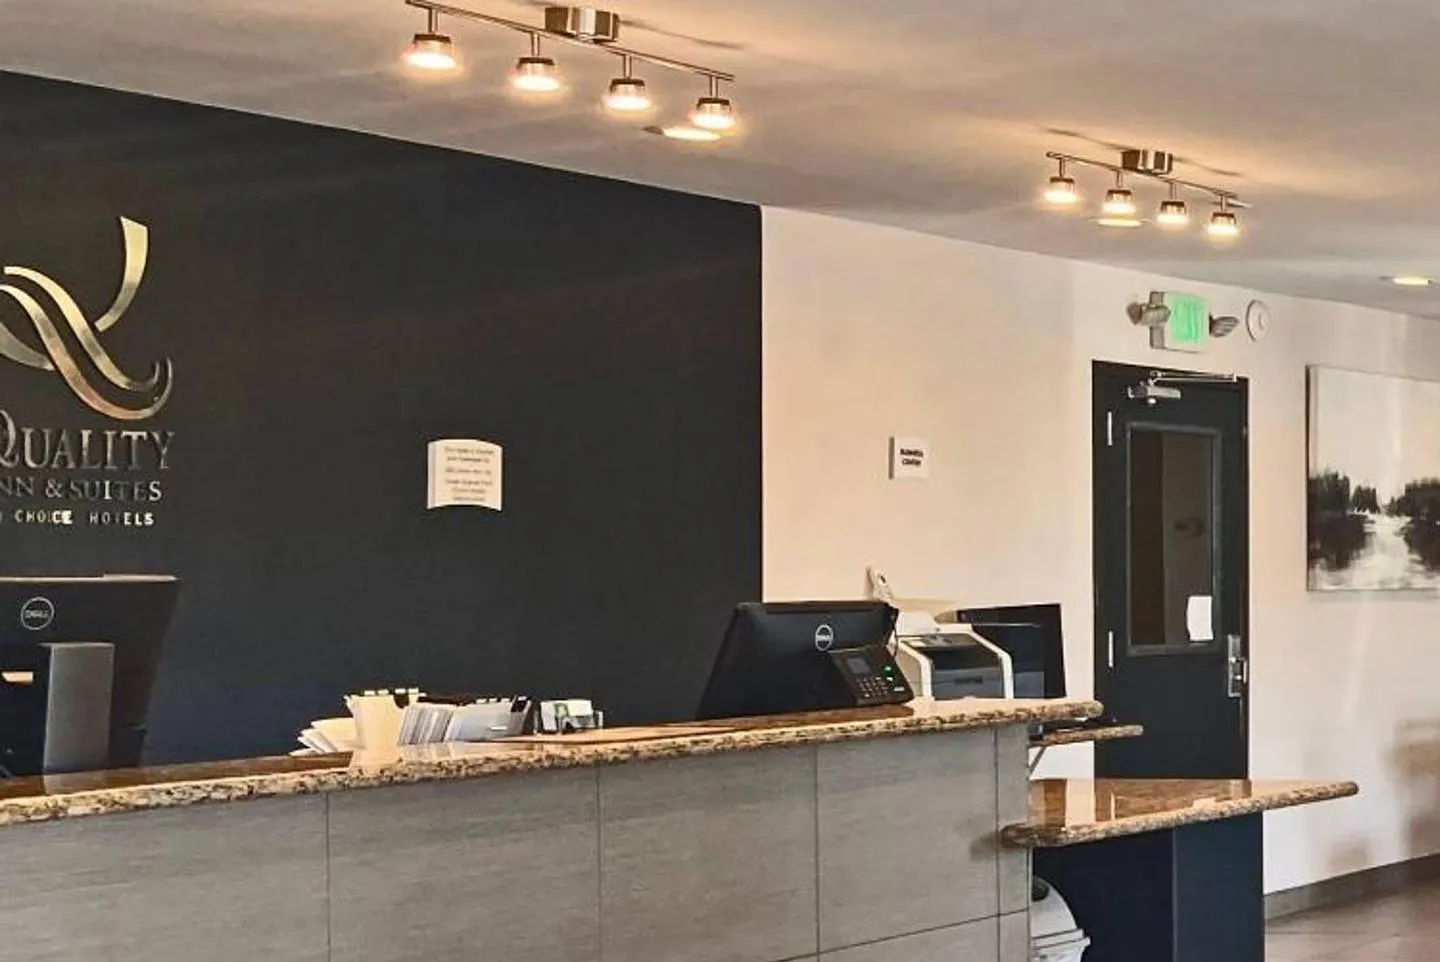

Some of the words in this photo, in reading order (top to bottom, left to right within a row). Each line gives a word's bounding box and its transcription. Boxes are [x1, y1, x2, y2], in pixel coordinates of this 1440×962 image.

[0, 476, 34, 498] NN
[45, 478, 63, 499] &
[70, 480, 163, 502] SUITES
[14, 508, 74, 526] CHOICE
